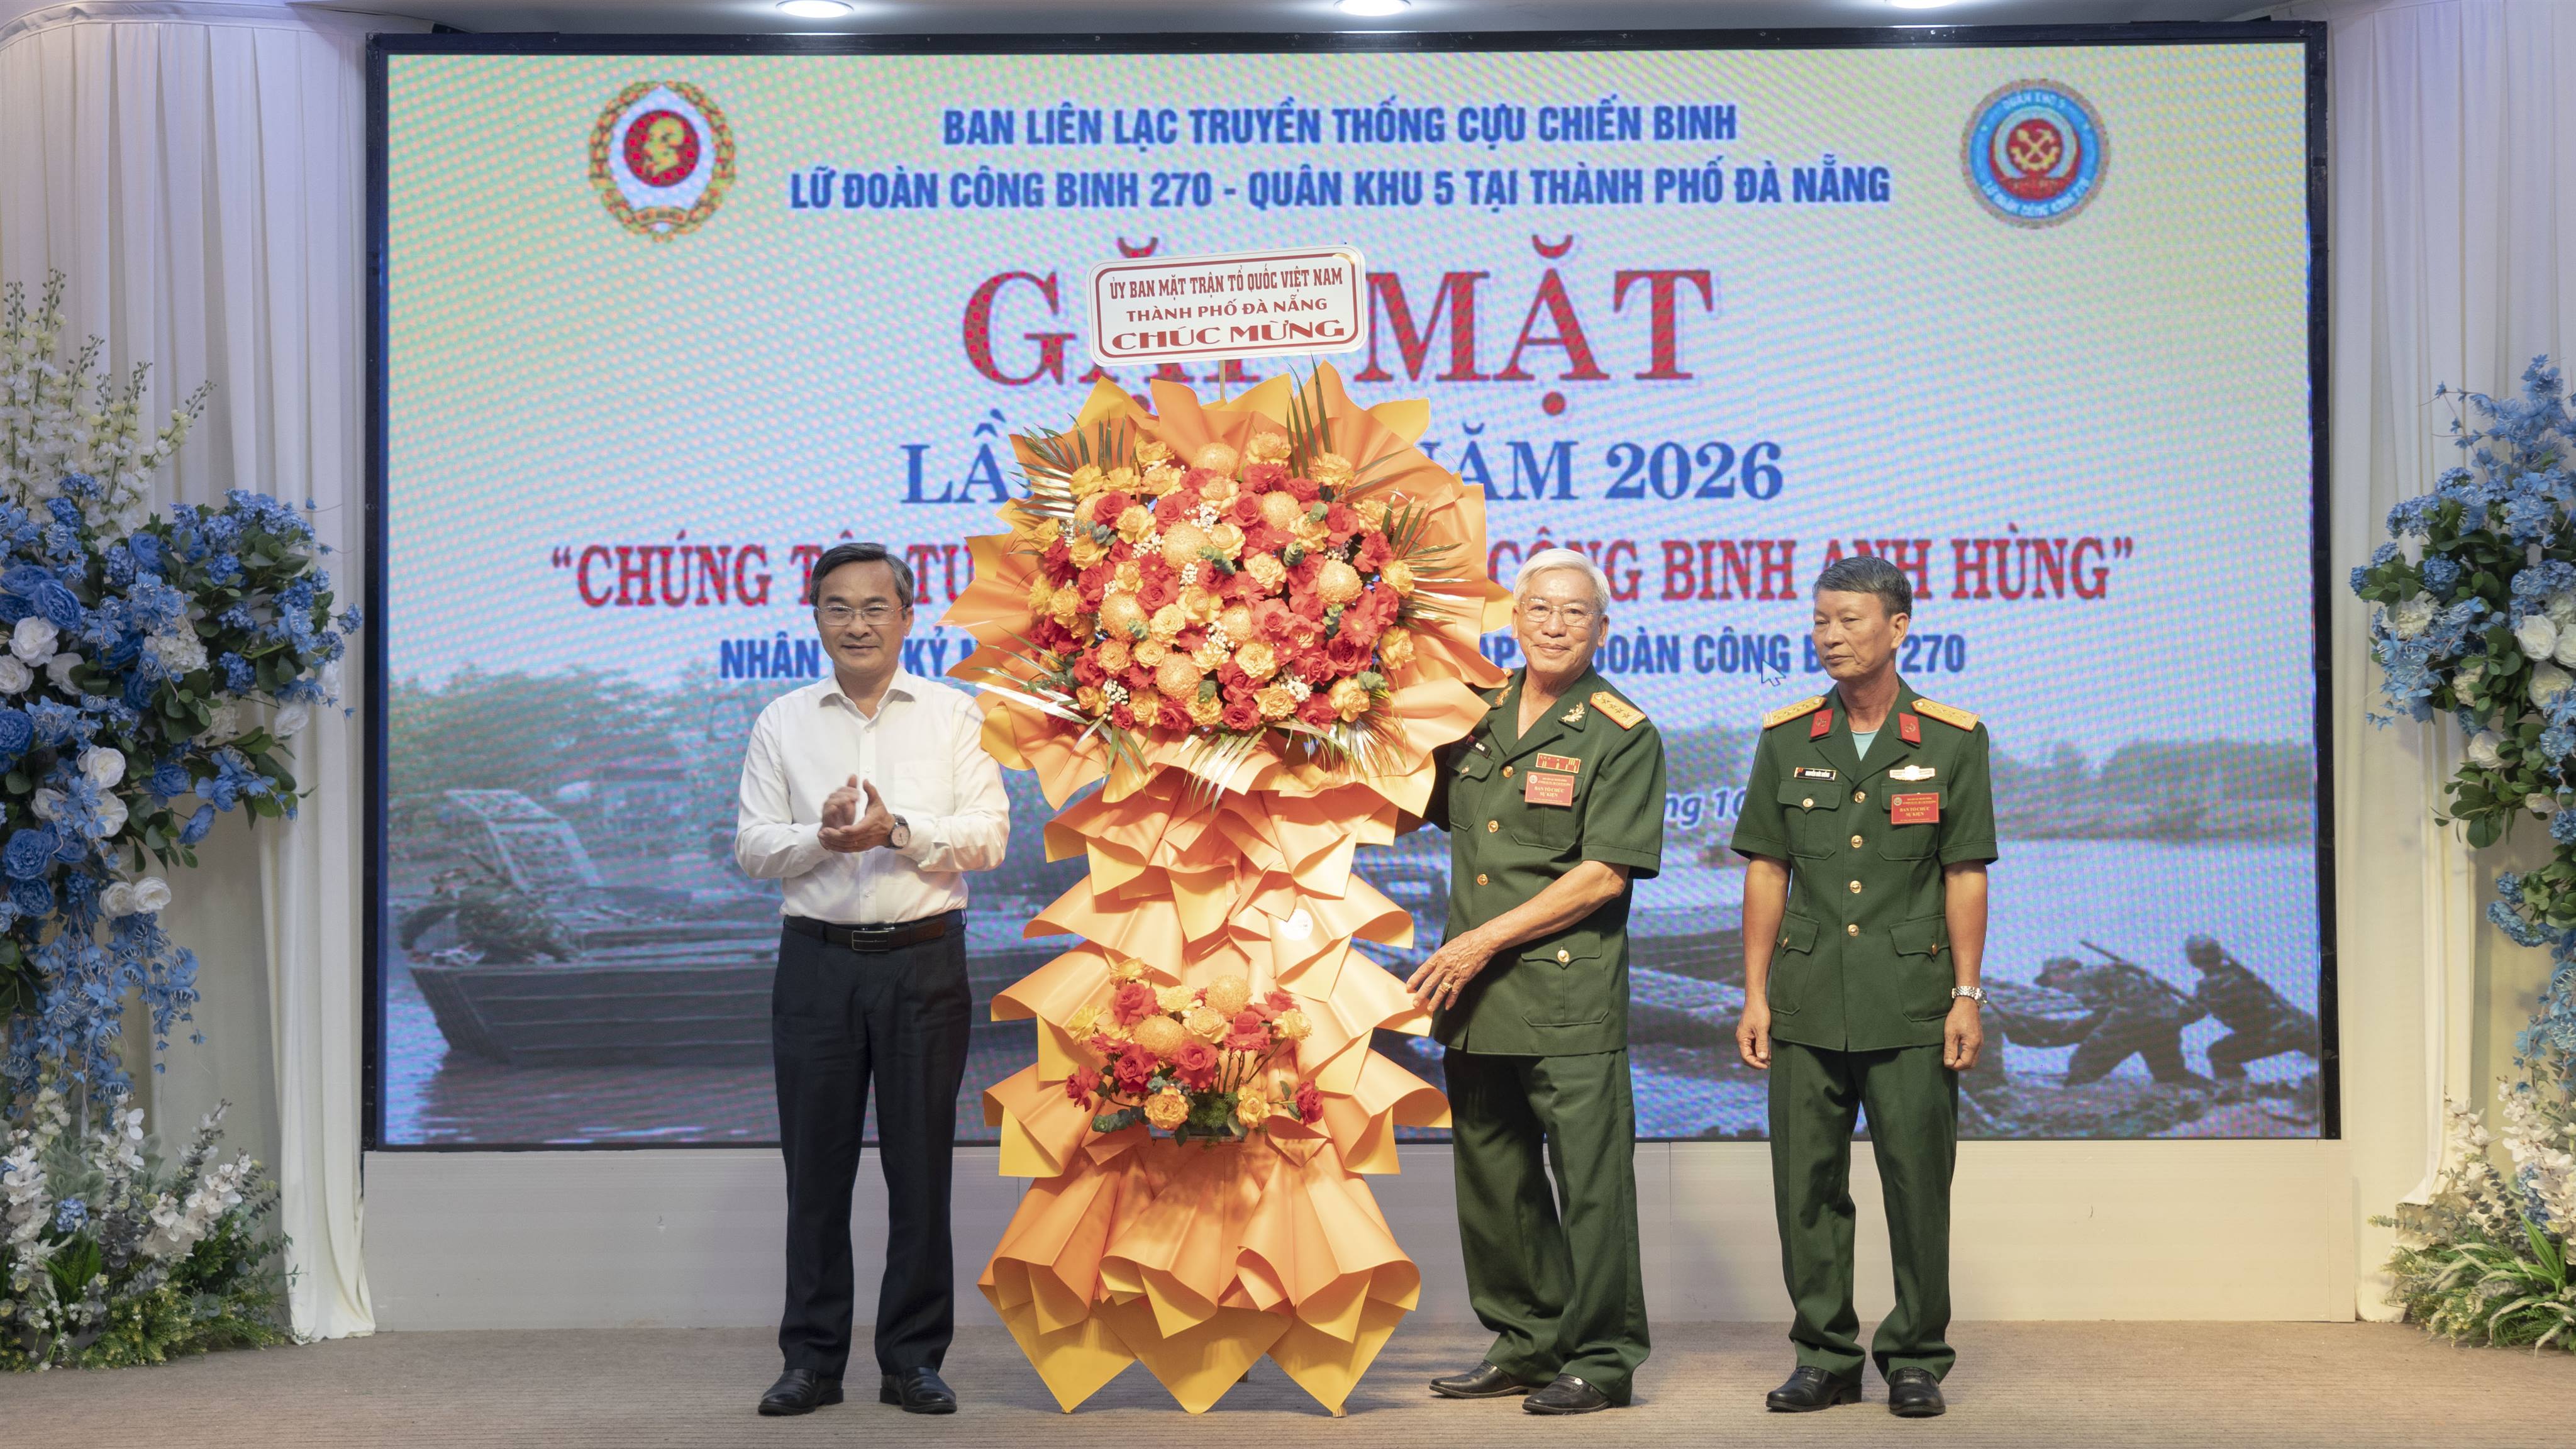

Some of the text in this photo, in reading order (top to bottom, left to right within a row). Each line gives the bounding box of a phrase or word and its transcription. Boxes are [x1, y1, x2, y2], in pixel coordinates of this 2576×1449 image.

[944, 94, 1737, 152] BAN LIÊN LẠC TRUYỀN THỐNG CỰU CHIẾN BINH
[791, 153, 1890, 213] LỮ ĐOÀN CÔNG BINH 270 - QUÂN KHU 5 TẠI THÀNH PHỐ ĐÀ NẴNG
[1110, 263, 1343, 301] ỦY BAN MẶT TRẬN TỔ QUỐC VIỆT NAM
[1126, 294, 1328, 322] THÀNH PHỐ ĐÀ NẴNG
[1112, 319, 1345, 350] CHÚC MỪNG
[1353, 235, 1714, 416] MẶT
[900, 409, 1784, 502] LẦ ĂM 2026
[1661, 539, 1797, 601] BINH
[721, 631, 819, 679] NHÂN
[904, 626, 948, 677] KỶ
[1694, 626, 1790, 674] CÔNG
[1901, 633, 1965, 672] 270
